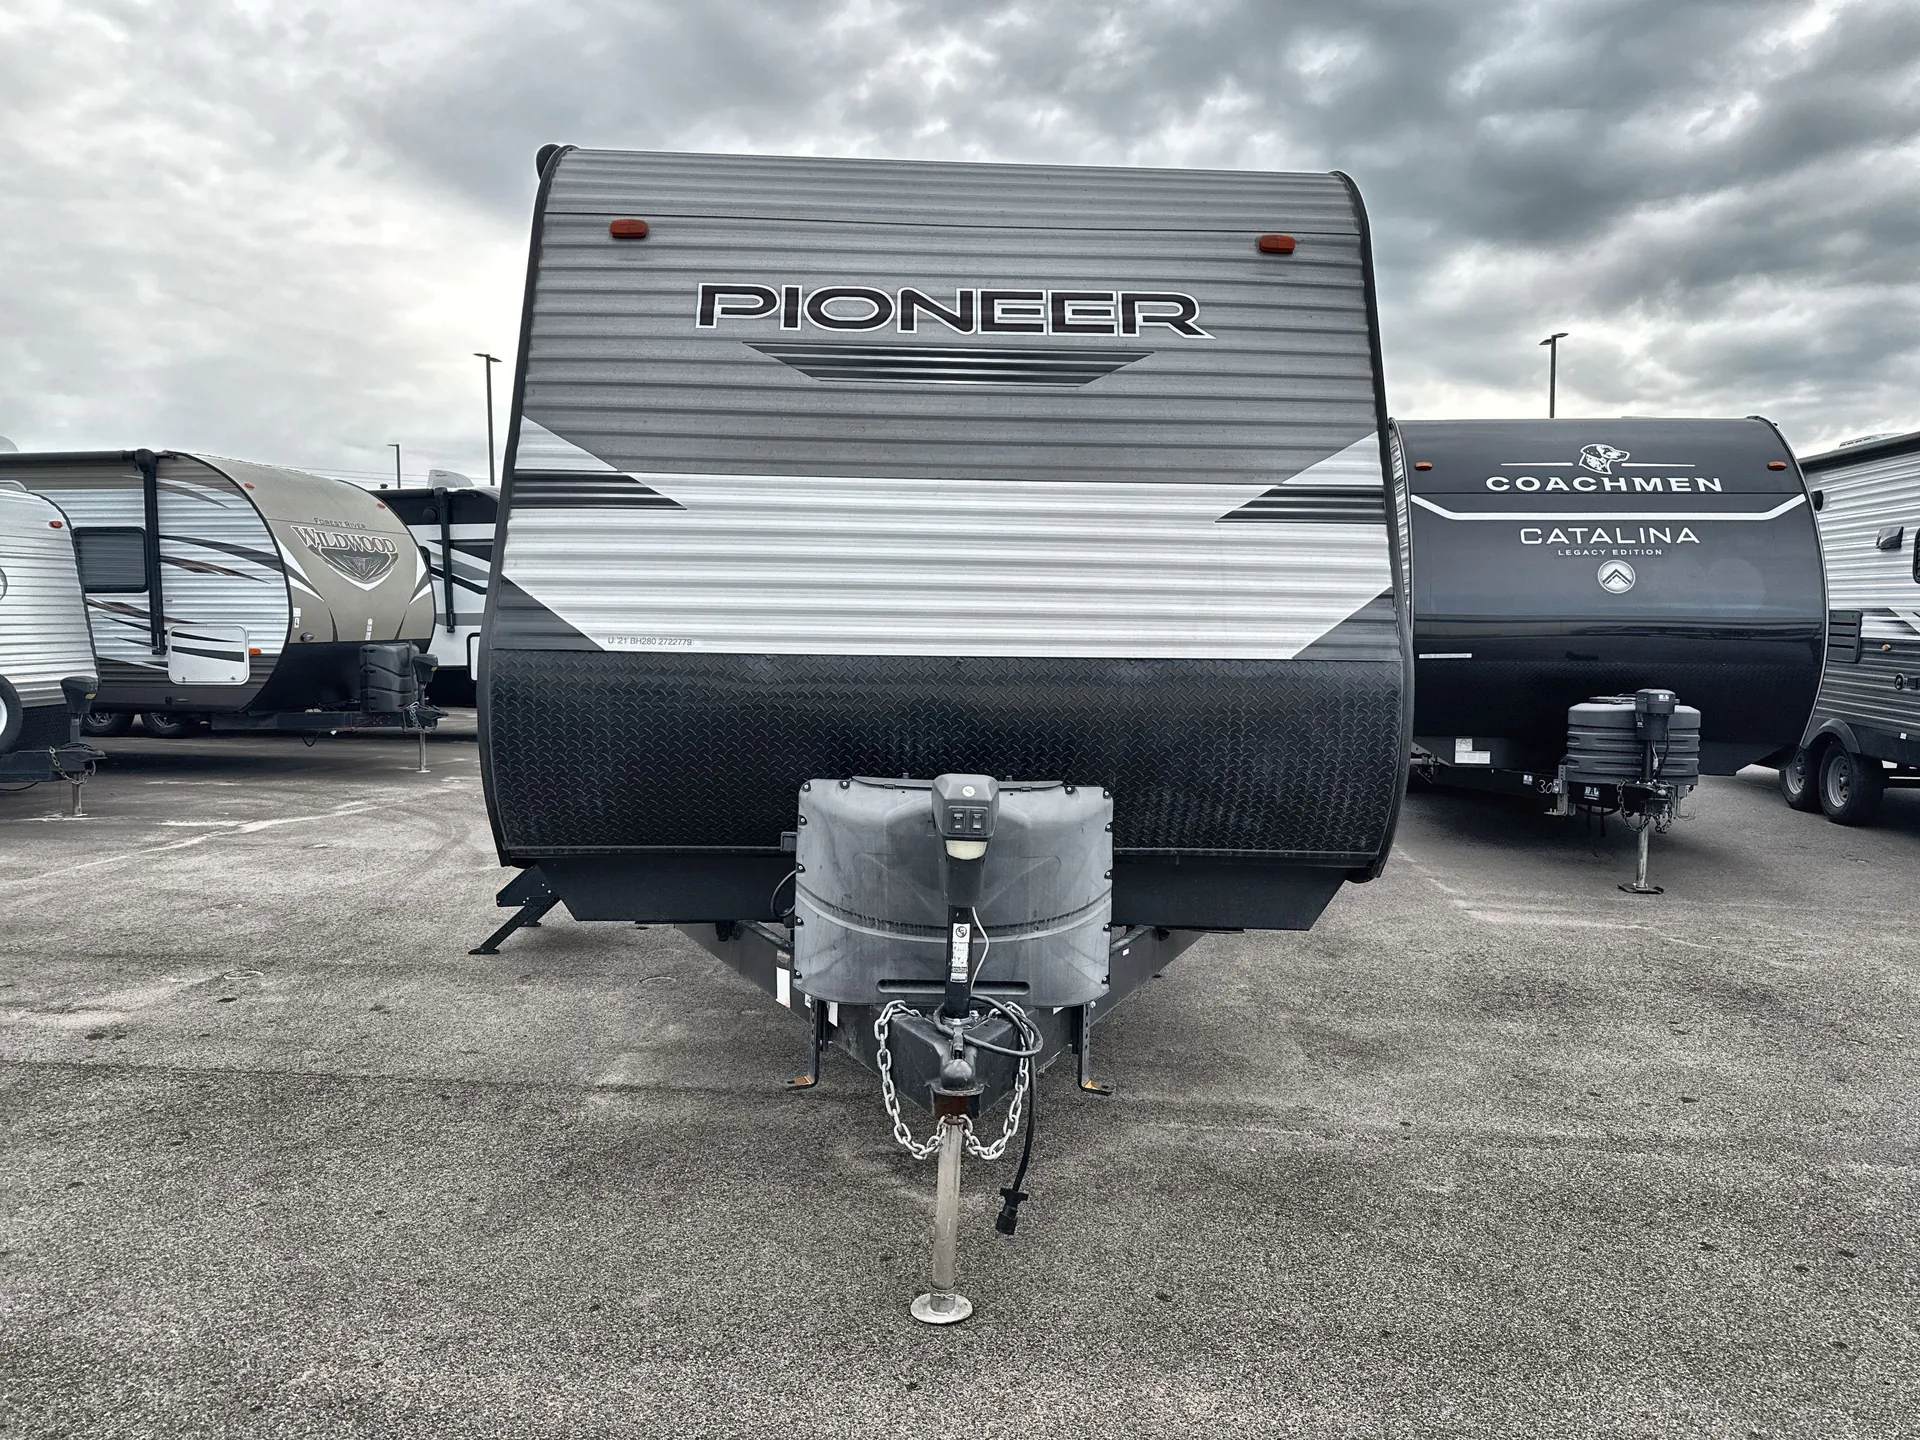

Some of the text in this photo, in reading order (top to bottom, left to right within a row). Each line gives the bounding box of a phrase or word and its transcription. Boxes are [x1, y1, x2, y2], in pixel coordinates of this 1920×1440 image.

[696, 282, 1216, 339] PIONEER
[1485, 476, 1723, 492] COACHMEN
[290, 525, 398, 553] WILDWOOD
[1520, 527, 1701, 544] CATALINA
[658, 638, 692, 646] 2722779
